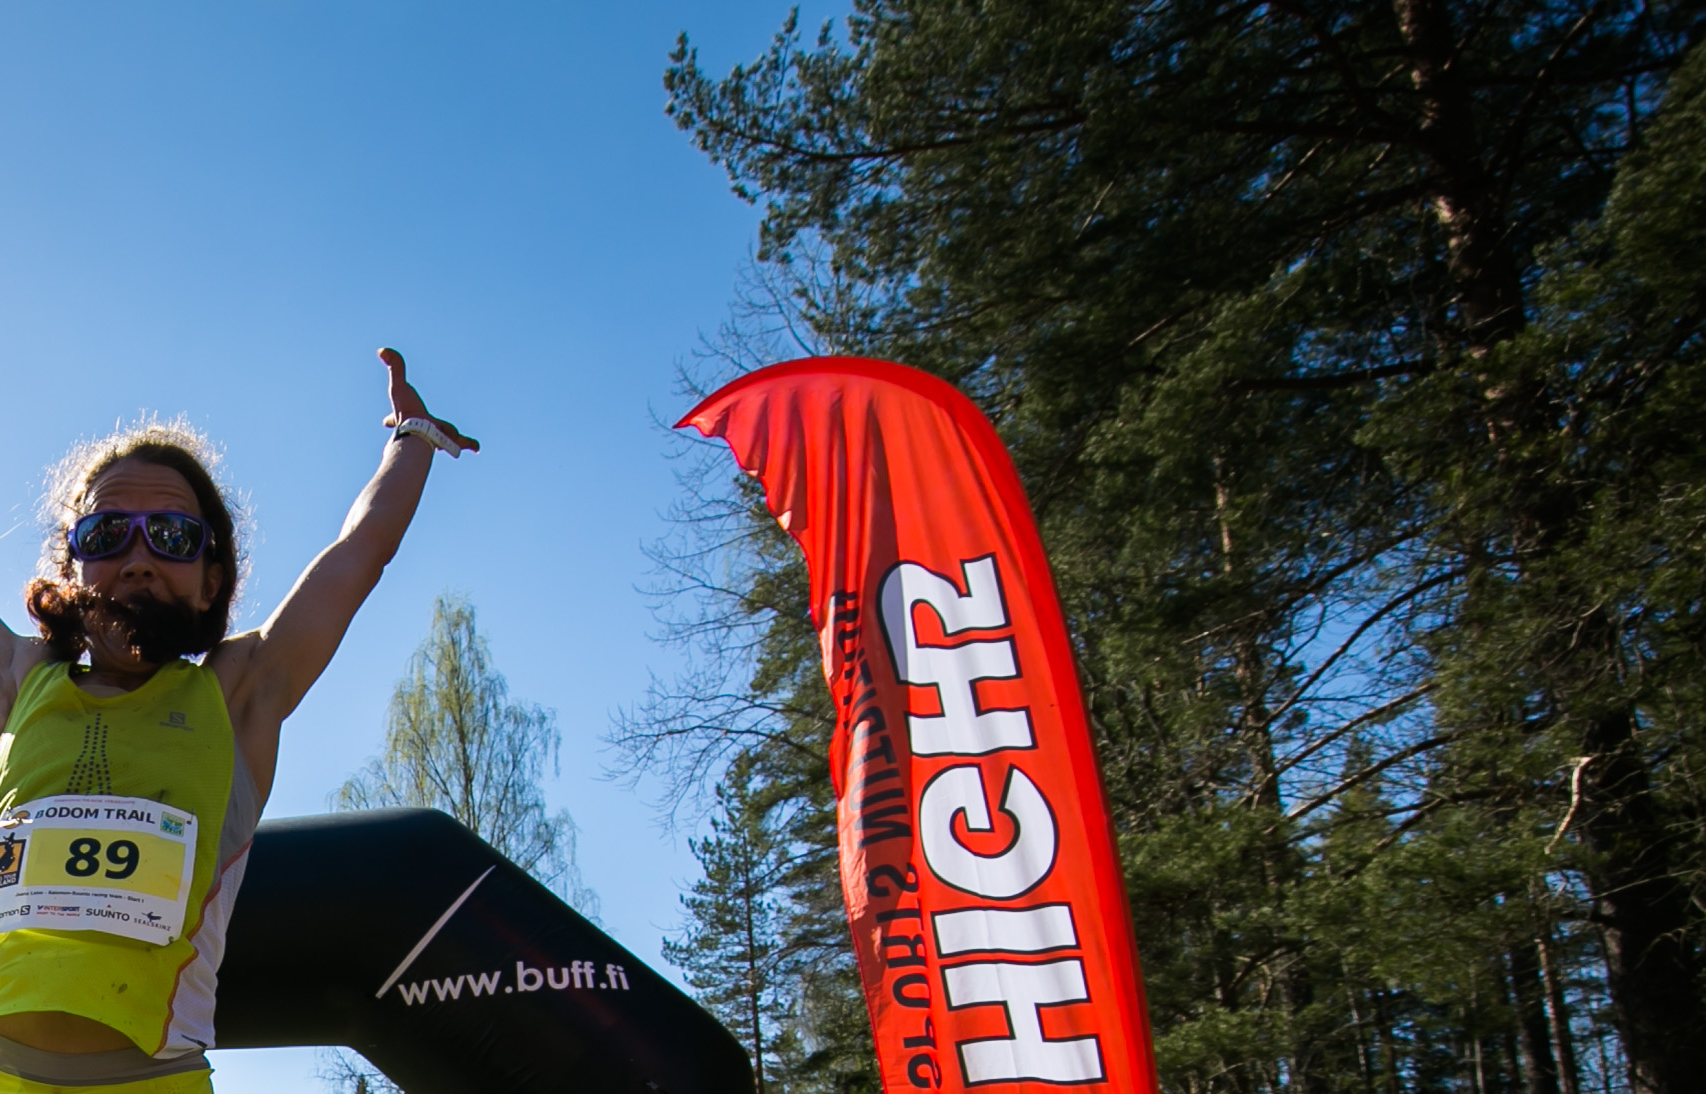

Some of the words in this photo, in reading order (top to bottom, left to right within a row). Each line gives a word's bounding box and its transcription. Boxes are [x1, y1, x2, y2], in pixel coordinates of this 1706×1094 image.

[35, 806, 98, 820] BODOM
[103, 808, 156, 825] TRAIL
[64, 837, 141, 880] 89
[85, 907, 131, 922] SUUNTO
[398, 960, 630, 1006] www.buff.fi
